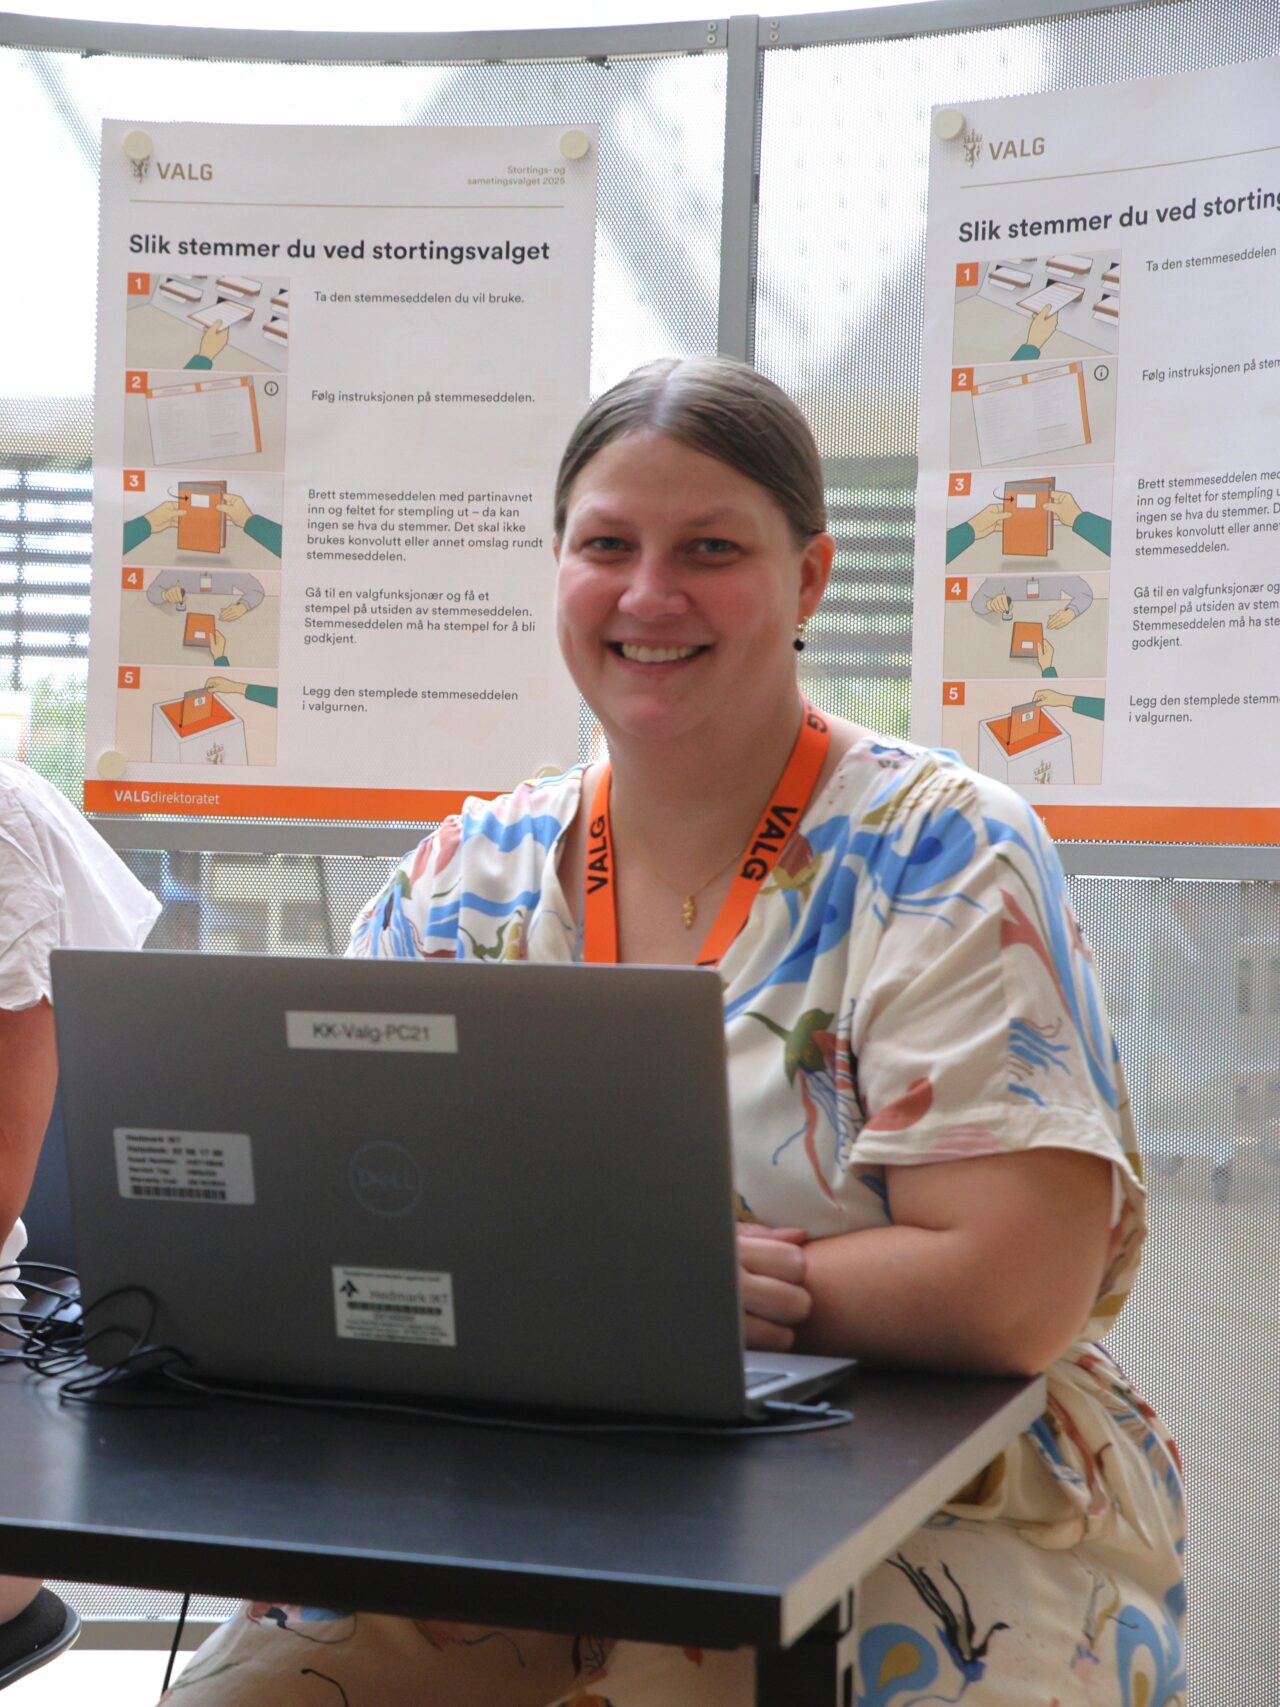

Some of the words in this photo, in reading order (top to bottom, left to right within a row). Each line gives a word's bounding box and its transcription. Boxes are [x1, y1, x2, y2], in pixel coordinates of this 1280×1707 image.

[988, 136, 1045, 160] VALG
[157, 162, 213, 181] VALG
[554, 166, 566, 175] og
[959, 220, 1000, 242] Slik
[1008, 214, 1112, 238] stemmer
[1119, 206, 1148, 227] du
[1156, 198, 1196, 223] ved
[129, 234, 170, 254] Slik
[178, 238, 280, 257] stemmer
[287, 238, 315, 258] du
[323, 240, 364, 259] ved
[372, 240, 550, 265] stortingsvalget
[1146, 260, 1158, 272] Ta
[1162, 258, 1182, 270] den
[1186, 246, 1276, 268] stemmeseddelen
[963, 268, 971, 281] 1
[135, 278, 142, 290] 1
[314, 291, 326, 302] Ta
[330, 292, 351, 302] den
[354, 292, 451, 303] stemmeseddelen
[455, 292, 469, 304] du
[472, 292, 485, 303] vil
[489, 292, 524, 303] bruke.
[1142, 369, 1165, 382] Følg
[1169, 363, 1240, 379] instruksjonen
[1244, 358, 1256, 374] på
[132, 376, 141, 388] 2
[958, 373, 967, 386] 2
[312, 390, 335, 404] Følg
[338, 390, 414, 404] instruksjonen
[417, 391, 431, 404] på
[434, 392, 535, 403] stemmeseddelen.
[129, 475, 139, 487] 3
[955, 478, 964, 491] 3
[1138, 478, 1165, 490] Brett
[1168, 472, 1257, 488] stemmeseddelen
[308, 489, 336, 500] Brett
[339, 490, 436, 502] stemmeseddelen
[440, 491, 464, 502] med
[468, 491, 532, 504] partinavnet
[1137, 495, 1154, 506] inn
[1157, 496, 1171, 507] og
[1174, 492, 1202, 504] feltet
[1204, 490, 1219, 502] for
[1221, 486, 1273, 501] stempling
[308, 504, 325, 514] inn
[328, 507, 342, 517] og
[346, 504, 375, 516] feltet
[378, 505, 395, 516] for
[398, 506, 454, 518] stempling
[458, 508, 469, 517] ut
[482, 506, 496, 517] da
[500, 507, 519, 517] kan
[1136, 512, 1167, 525] ingen
[1170, 512, 1182, 521] se
[1186, 509, 1203, 520] hva
[1206, 507, 1219, 519] du
[1222, 506, 1269, 517] stemmer.
[308, 520, 339, 532] ingen
[342, 522, 354, 530] se
[358, 520, 377, 530] hva
[380, 520, 395, 531] du
[398, 519, 451, 532] stemmer.
[454, 521, 474, 532] Det
[478, 522, 499, 532] skal
[503, 522, 526, 532] ikke
[1136, 528, 1173, 540] brukes
[1176, 524, 1225, 538] konvolutt
[1228, 523, 1250, 534] eller
[1253, 522, 1280, 532] anne
[307, 534, 345, 545] brukes
[348, 535, 401, 546] konvolutt
[405, 536, 430, 547] eller
[432, 538, 464, 547] annet
[468, 537, 508, 550] omslag
[512, 537, 543, 548] rundt
[1136, 541, 1229, 556] stemmeseddelen.
[306, 550, 406, 562] stemmeseddelen.
[127, 573, 137, 584] 4
[305, 587, 321, 598] Gå
[324, 588, 335, 598] til
[338, 590, 352, 598] en
[356, 588, 444, 602] valgfunksjonær
[446, 593, 461, 603] og
[464, 590, 474, 600] få
[478, 592, 489, 601] et
[951, 582, 961, 595] 4
[1134, 586, 1149, 598] Gå
[1152, 586, 1163, 598] til
[1166, 588, 1179, 597] en
[1182, 582, 1264, 597] valgfunksjonær
[305, 603, 350, 615] stempel
[354, 603, 367, 616] på
[371, 604, 412, 615] utsiden
[416, 607, 428, 615] av
[432, 606, 532, 616] stemmeseddelen.
[1133, 602, 1176, 616] stempel
[1180, 601, 1192, 614] på
[1196, 600, 1234, 612] utsiden
[1238, 602, 1250, 611] av
[305, 617, 403, 630] Stemmeseddelen
[406, 620, 424, 630] må
[427, 620, 440, 630] ha
[444, 620, 489, 633] stempel
[492, 621, 508, 631] for
[512, 621, 518, 632] å
[522, 621, 535, 632] bli
[1132, 616, 1226, 632] Stemmeseddelen
[1229, 616, 1246, 628] må
[1247, 616, 1261, 627] ha
[304, 632, 356, 646] godkjent.
[1132, 635, 1182, 650] godkjent.
[124, 672, 133, 683] 5
[303, 686, 330, 698] Legg
[334, 686, 355, 696] den
[358, 688, 418, 700] stemplede
[421, 689, 518, 700] stemmeseddelen
[949, 688, 958, 701] 5
[302, 700, 305, 710] i
[308, 702, 367, 714] valgurnen.
[1130, 695, 1157, 709] Legg
[1160, 694, 1180, 706] den
[1184, 693, 1240, 708] stemplede
[1243, 694, 1280, 704] stemm
[1129, 712, 1132, 722] i
[1135, 711, 1192, 726] valgurnen.
[114, 790, 220, 804] VALGdirektoratet
[741, 805, 798, 881] VALG
[587, 815, 608, 894] VALG
[312, 1023, 430, 1042] KK-Valg-PC21
